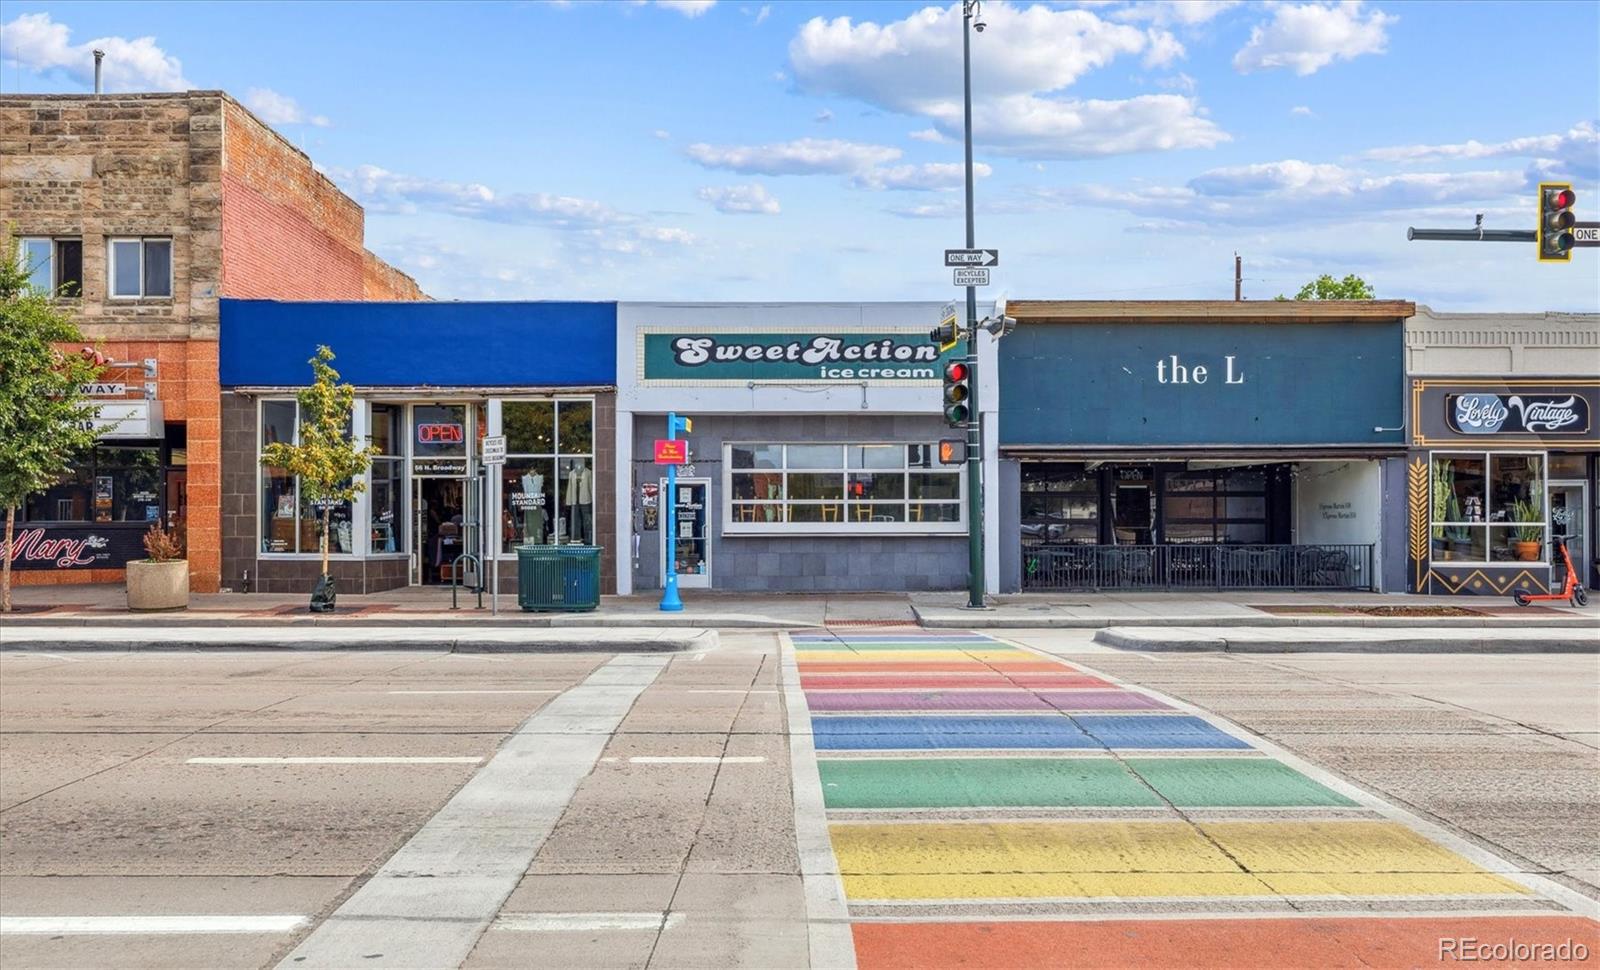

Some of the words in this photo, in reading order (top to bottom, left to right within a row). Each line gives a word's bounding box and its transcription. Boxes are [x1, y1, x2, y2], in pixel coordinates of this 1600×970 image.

[1575, 229, 1599, 240] ONE
[674, 336, 799, 365] Sweet
[802, 336, 940, 365] Action
[821, 366, 858, 378] ice
[858, 367, 935, 378] cream
[1156, 355, 1208, 384] the
[1224, 355, 1244, 384] L
[1456, 395, 1508, 427] Lovely
[1508, 395, 1579, 432] Vintage
[420, 425, 462, 441] OPEN
[432, 464, 467, 472] Broadway
